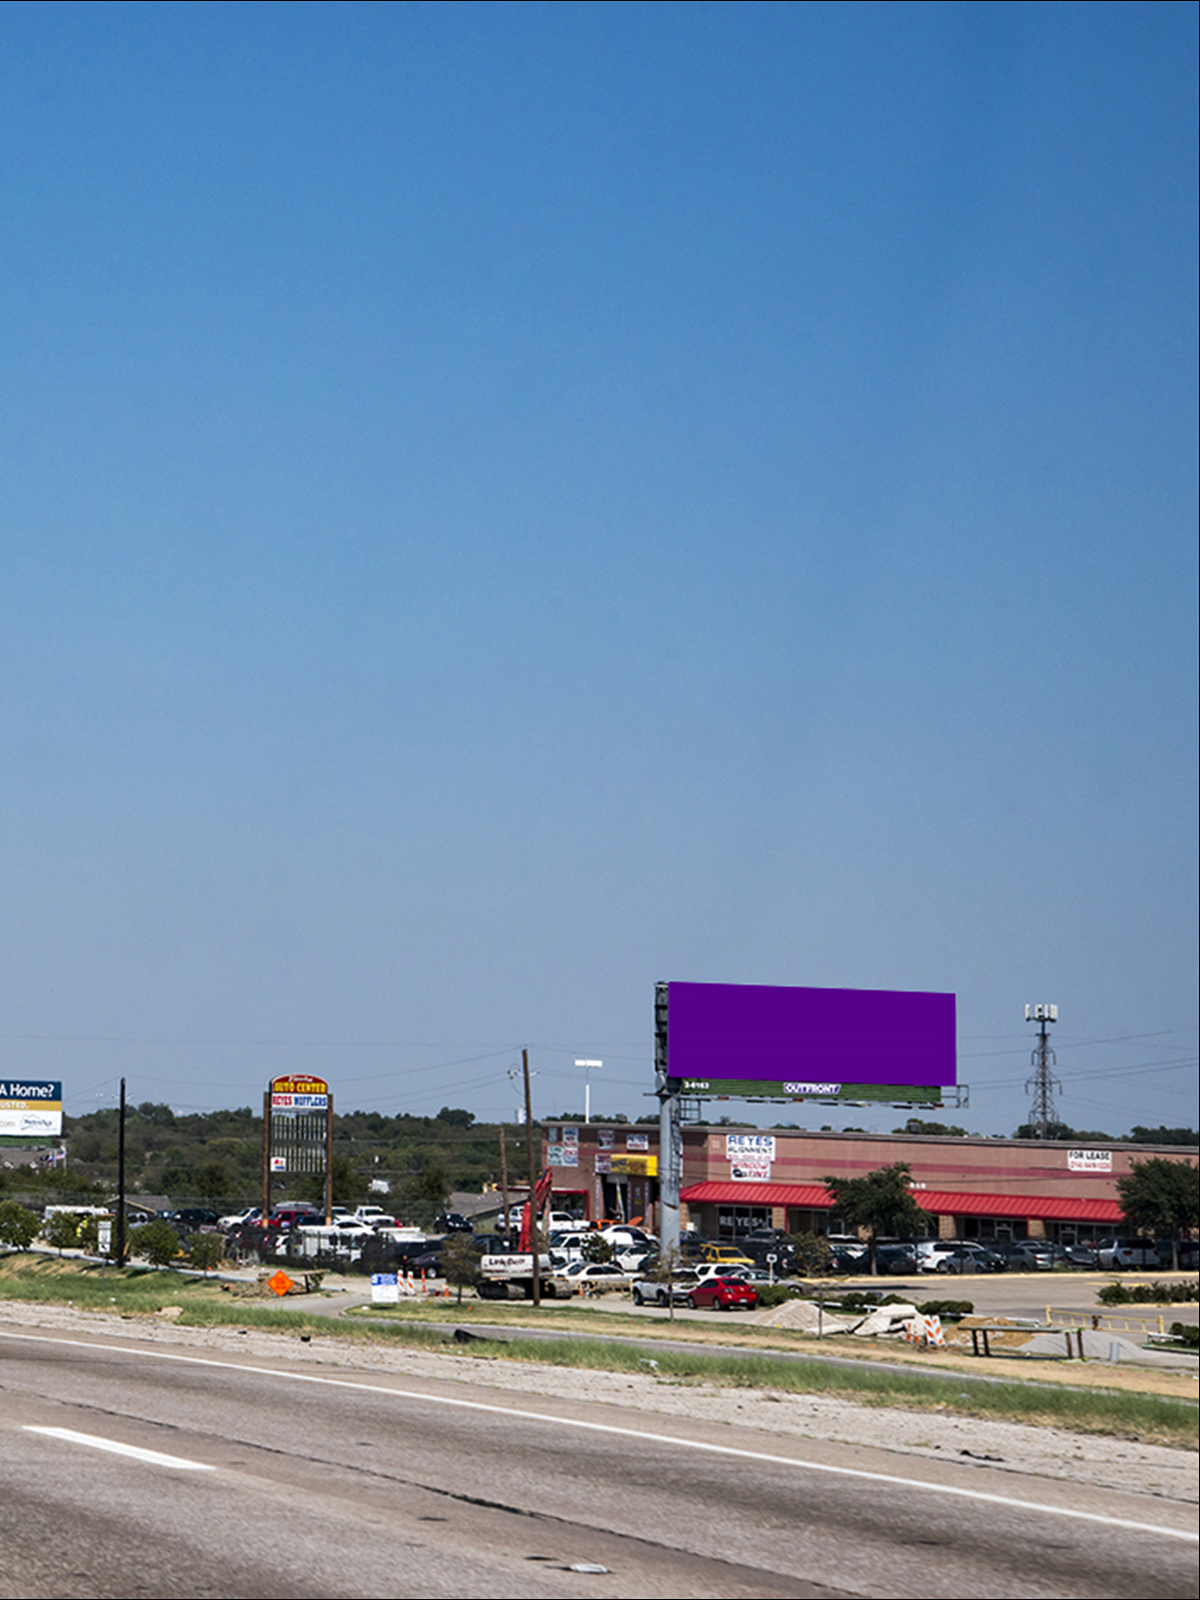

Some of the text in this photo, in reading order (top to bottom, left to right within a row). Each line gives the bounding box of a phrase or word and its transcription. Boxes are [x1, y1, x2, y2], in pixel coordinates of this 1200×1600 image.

[10, 1084, 55, 1098] Home?
[274, 1082, 327, 1093] AUTO CENTER
[728, 1135, 774, 1147] REYES
[1069, 1151, 1110, 1161] FOR LEASE
